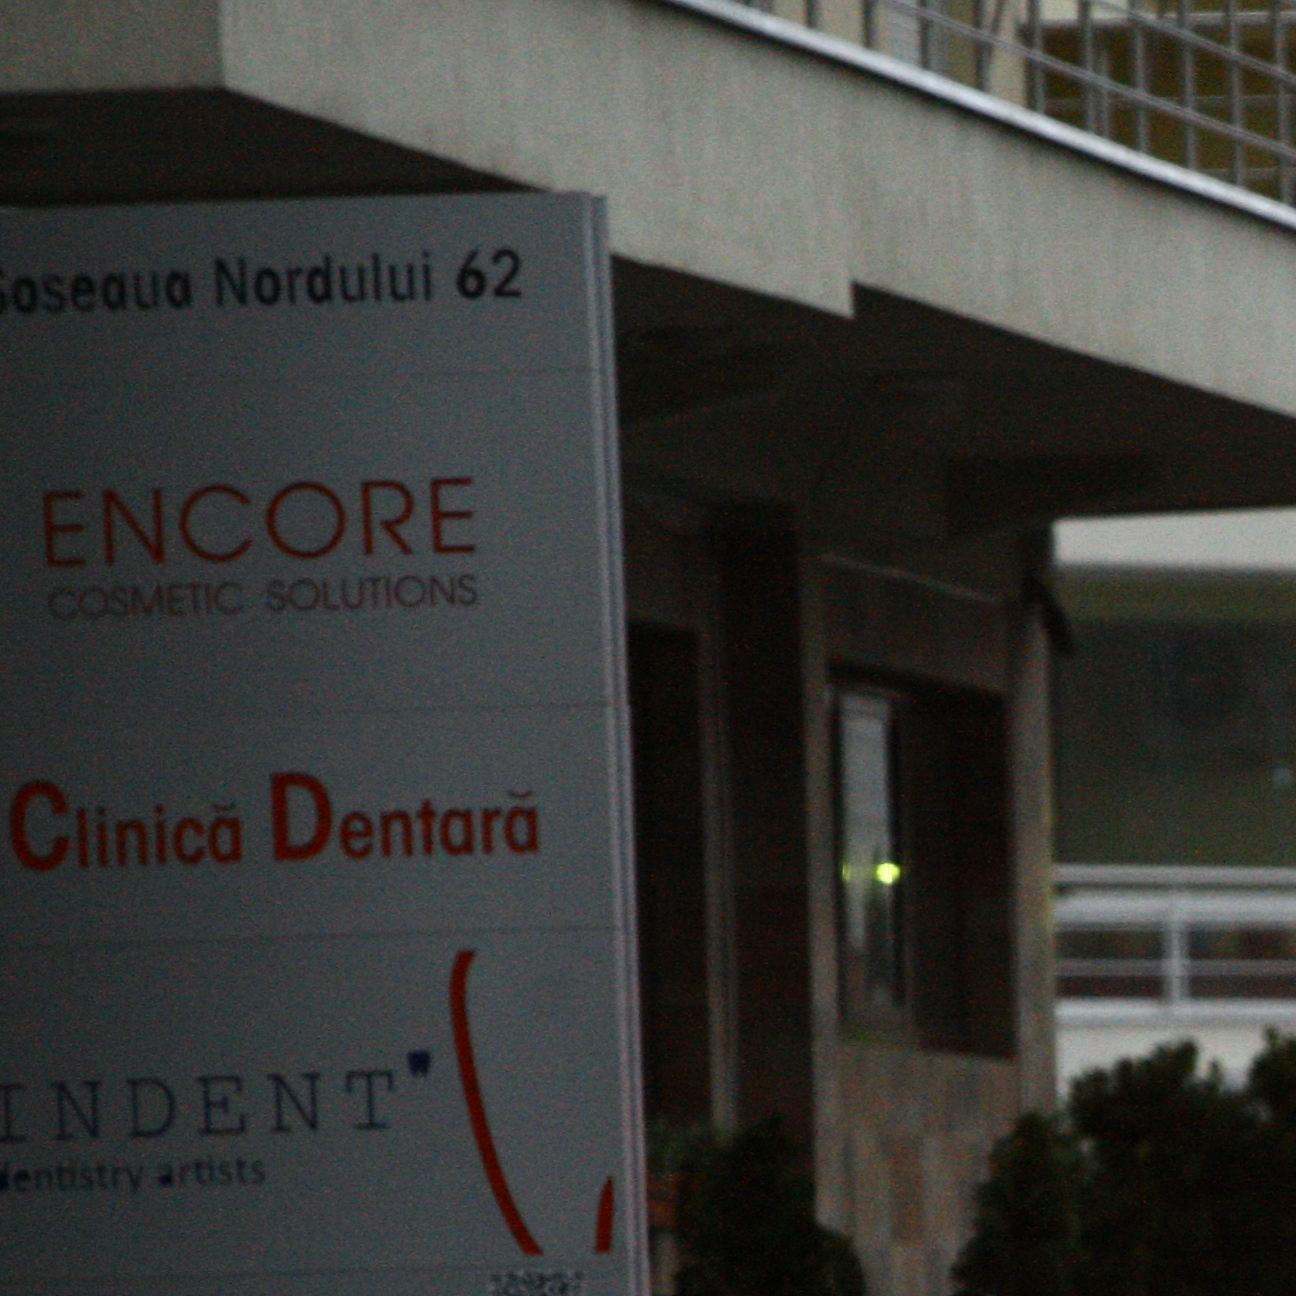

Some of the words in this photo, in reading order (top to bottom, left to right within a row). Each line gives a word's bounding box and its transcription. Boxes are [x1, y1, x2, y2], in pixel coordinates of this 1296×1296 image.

[0, 267, 193, 314] oseaua
[214, 251, 433, 307] Nordului
[456, 249, 523, 300] 62
[43, 477, 476, 567] ENCORE
[48, 580, 244, 621] COSMETIC
[267, 574, 478, 613] SOLUTIONS
[10, 780, 243, 871] Clinică
[271, 772, 540, 862] Dentară
[0, 1070, 394, 1143] INDENT
[157, 1157, 266, 1188] artists
